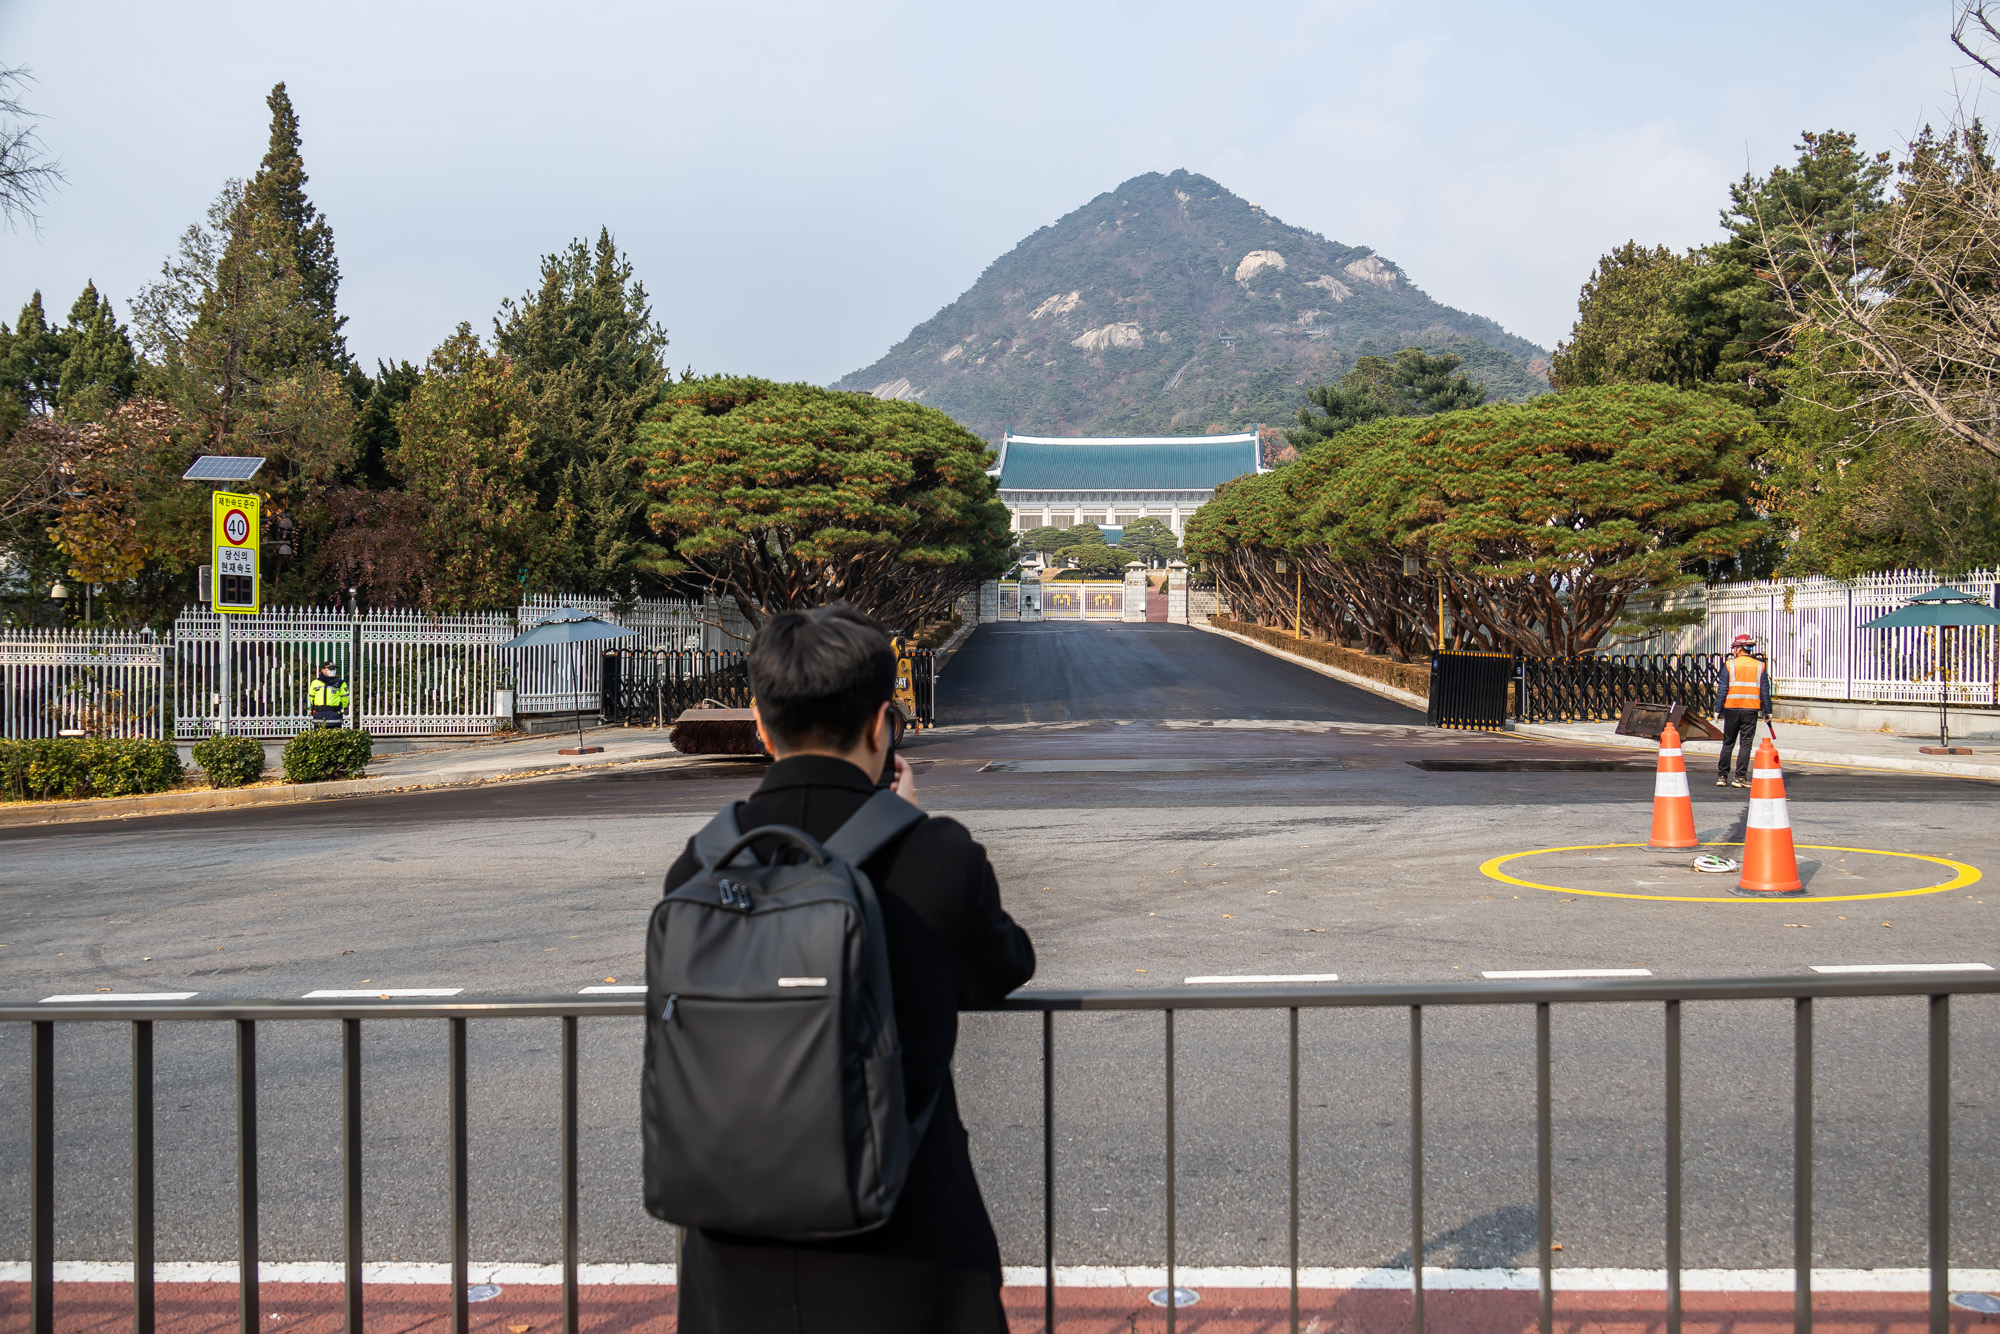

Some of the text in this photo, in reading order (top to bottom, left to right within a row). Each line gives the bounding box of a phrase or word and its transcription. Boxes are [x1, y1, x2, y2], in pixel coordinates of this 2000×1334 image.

[218, 497, 255, 509] 제한속도준수
[228, 519, 245, 536] 40
[225, 549, 248, 561] 당신의
[221, 561, 252, 573] 현재속도
